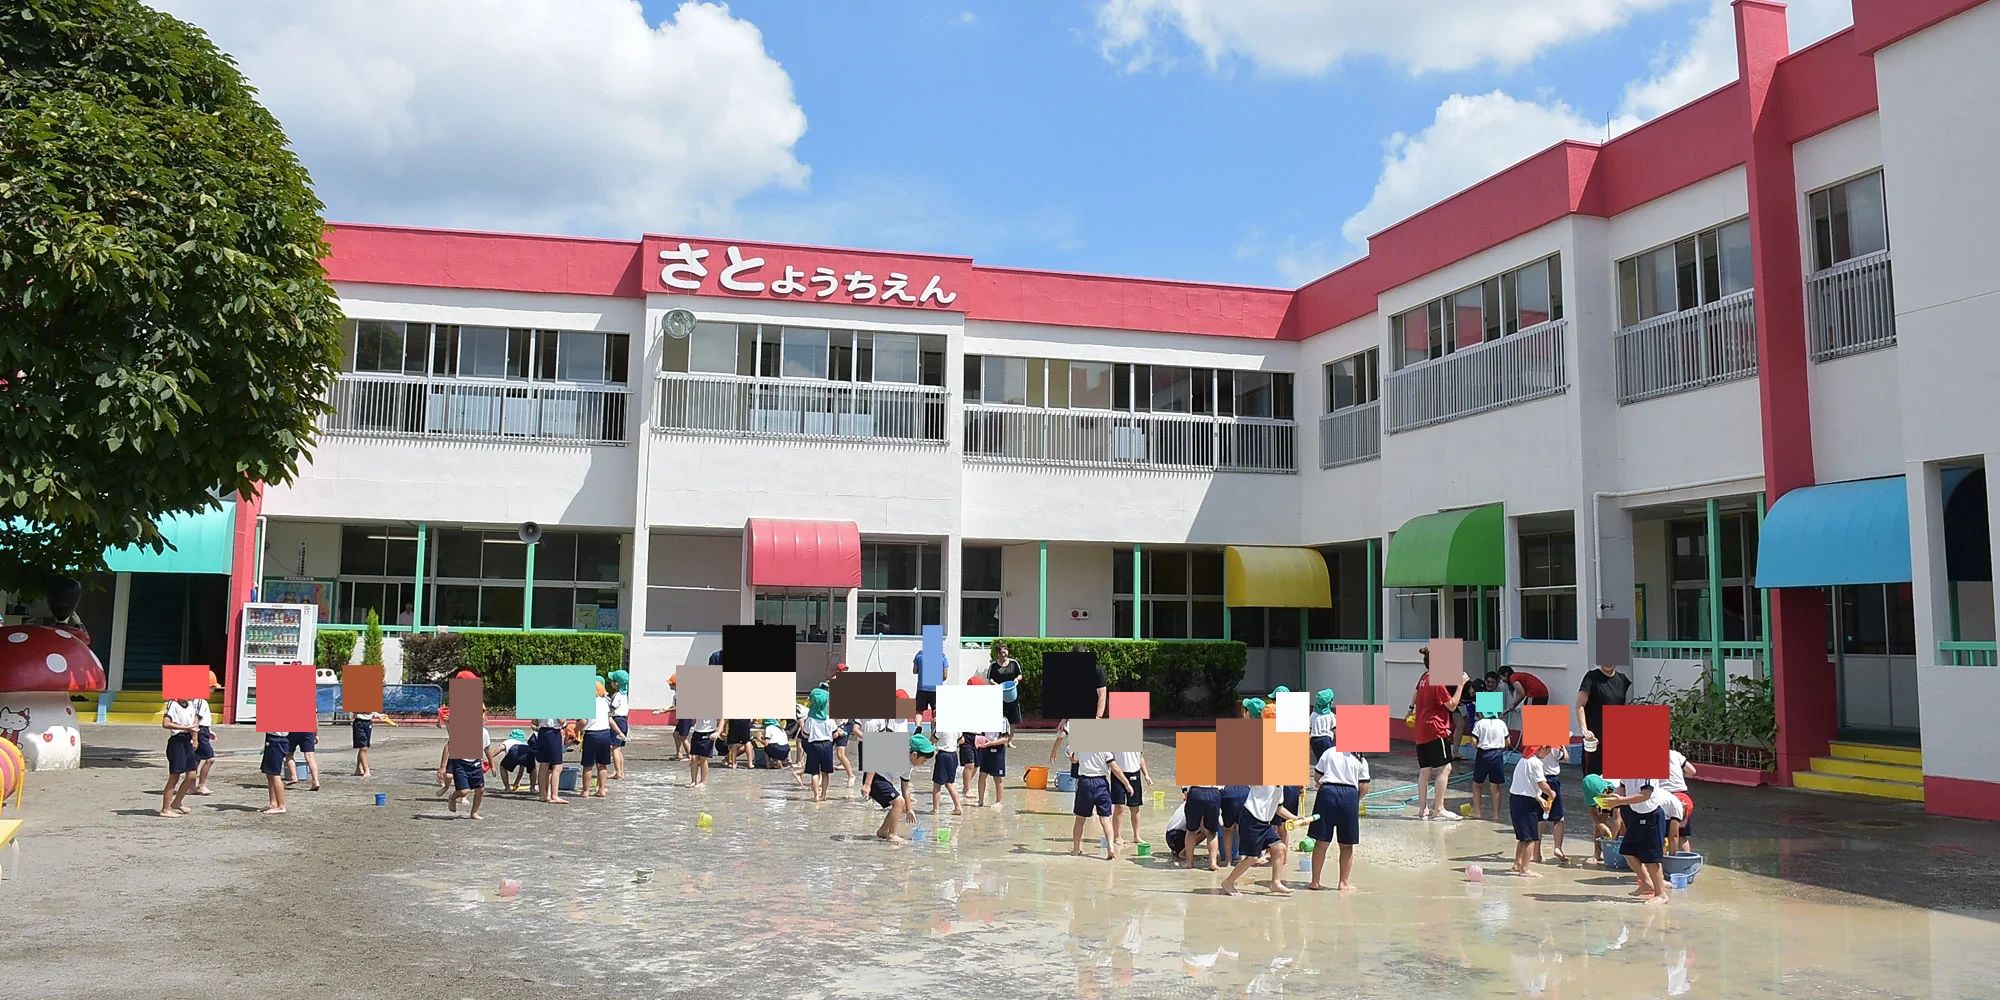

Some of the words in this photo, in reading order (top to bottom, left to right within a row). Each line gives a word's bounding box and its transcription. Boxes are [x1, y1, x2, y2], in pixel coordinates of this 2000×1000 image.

[659, 243, 957, 304] さとようちえん
